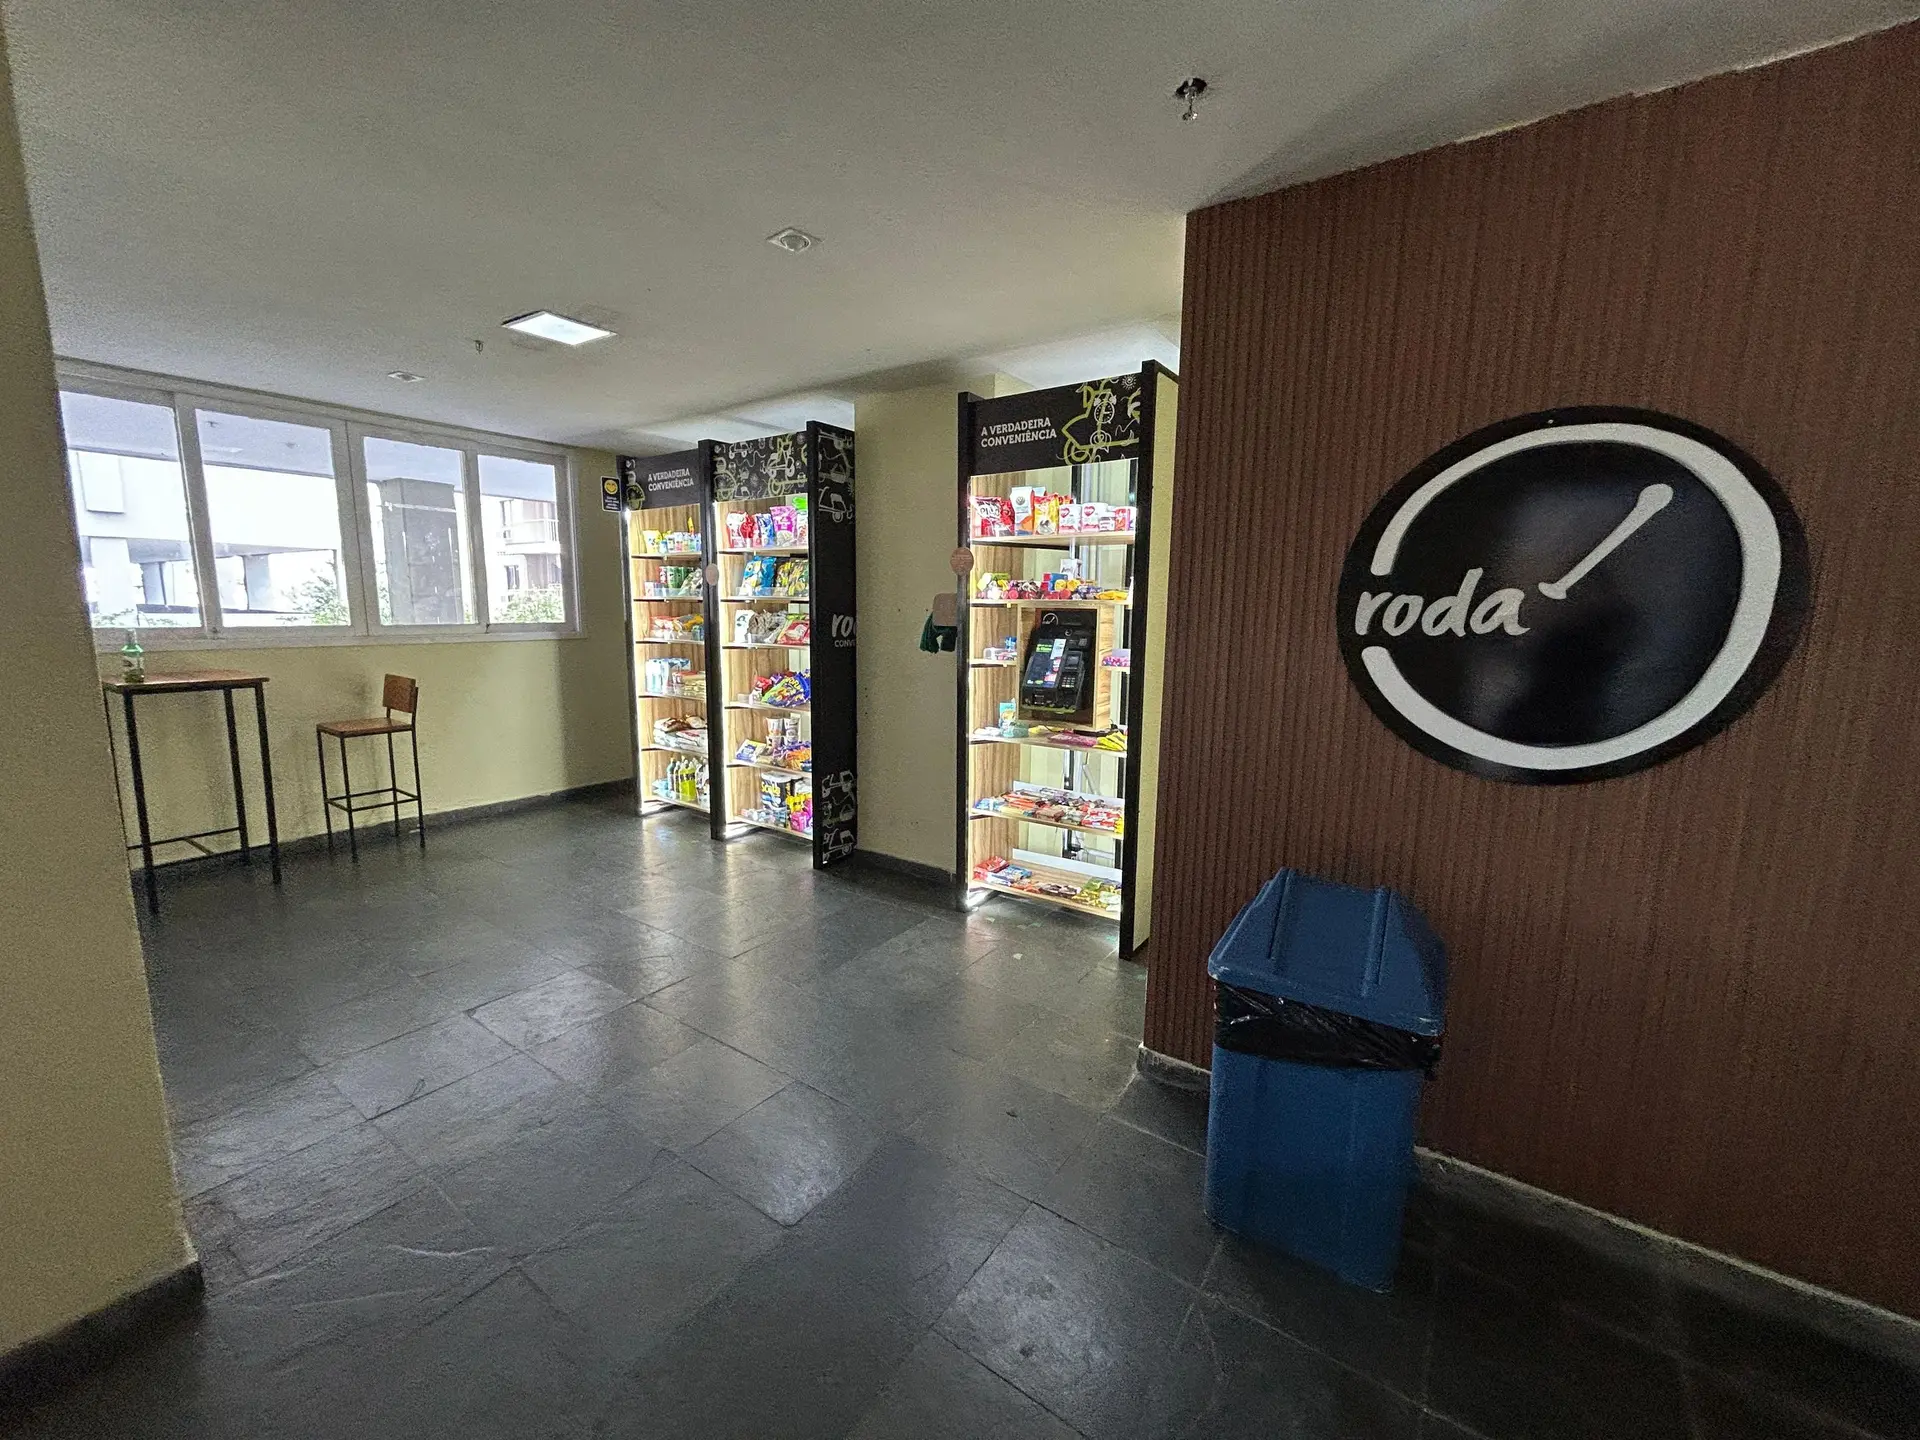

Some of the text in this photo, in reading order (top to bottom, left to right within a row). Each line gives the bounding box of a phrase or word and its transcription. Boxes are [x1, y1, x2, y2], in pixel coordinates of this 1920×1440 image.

[981, 417, 1051, 436] A VERDADEIRA
[981, 429, 1057, 447] CONVENIÊNCIA
[648, 468, 690, 482] A VERDADEIRA
[648, 478, 694, 491] CONVENIÊNCIA
[1355, 567, 1531, 637] roda
